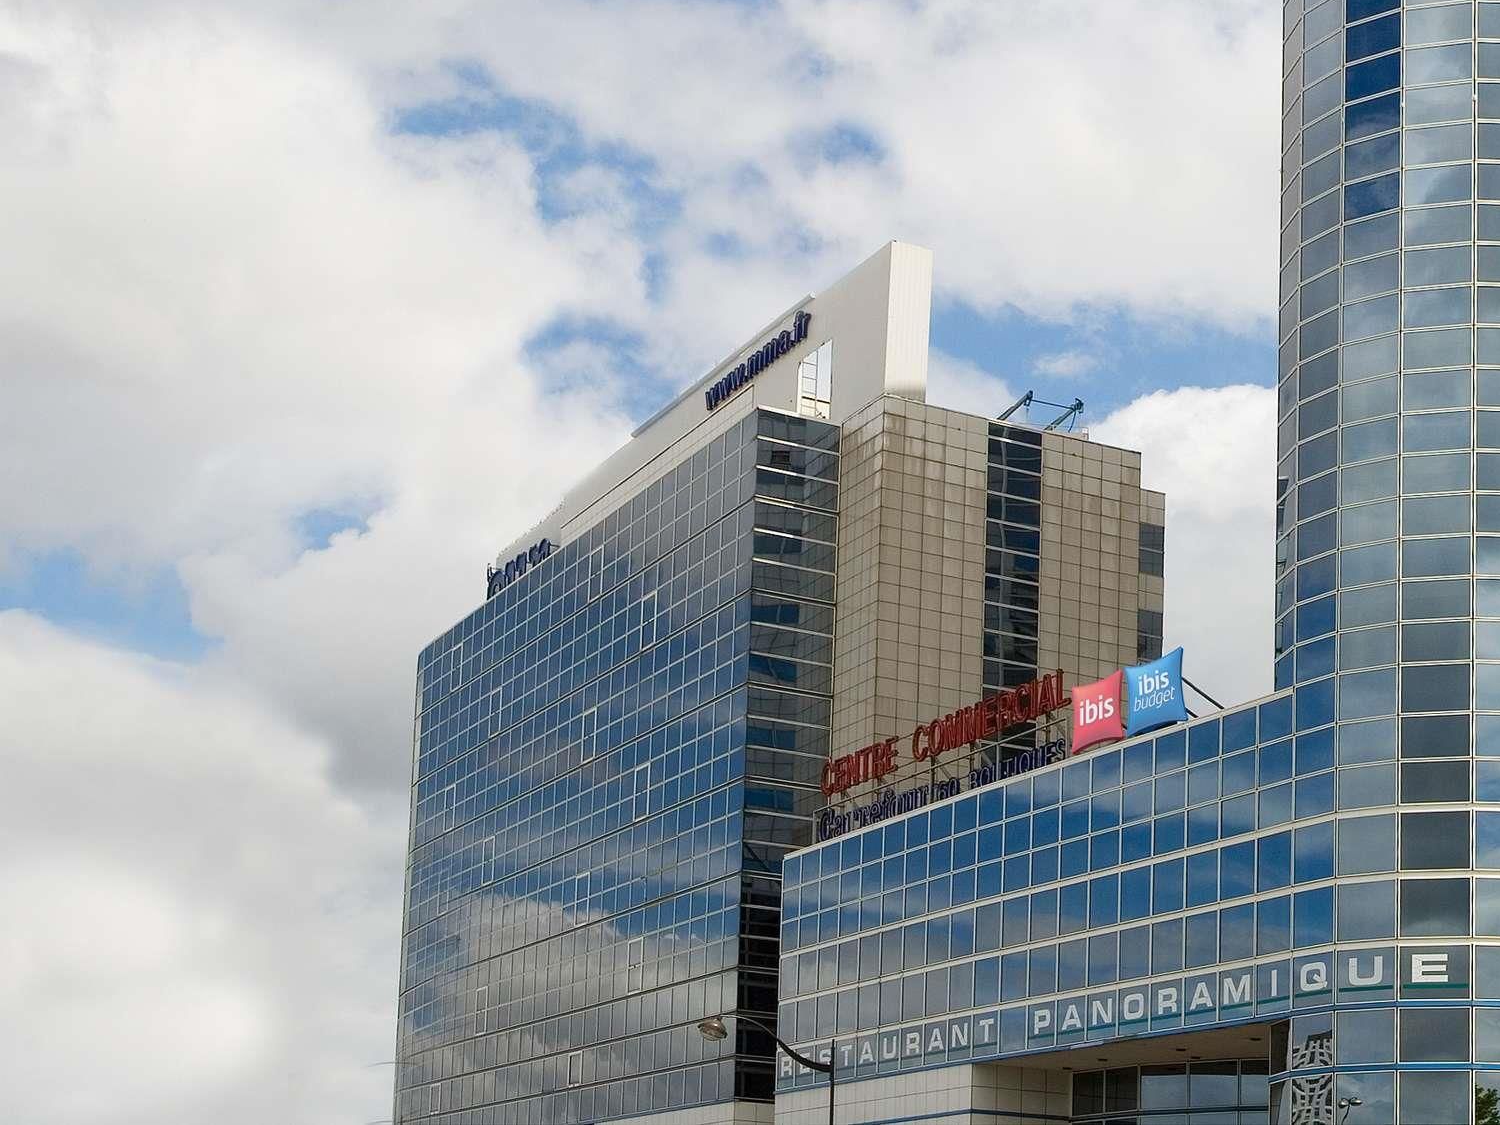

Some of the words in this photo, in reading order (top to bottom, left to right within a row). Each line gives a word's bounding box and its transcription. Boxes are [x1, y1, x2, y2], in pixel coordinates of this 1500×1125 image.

[1133, 686, 1176, 713] budget
[1138, 670, 1170, 696] ibis
[1080, 694, 1115, 727] ibis
[821, 735, 899, 797] CENTRE
[912, 668, 1072, 763] COMMERCIAL
[1033, 954, 1450, 1036] PANORAMIQUE
